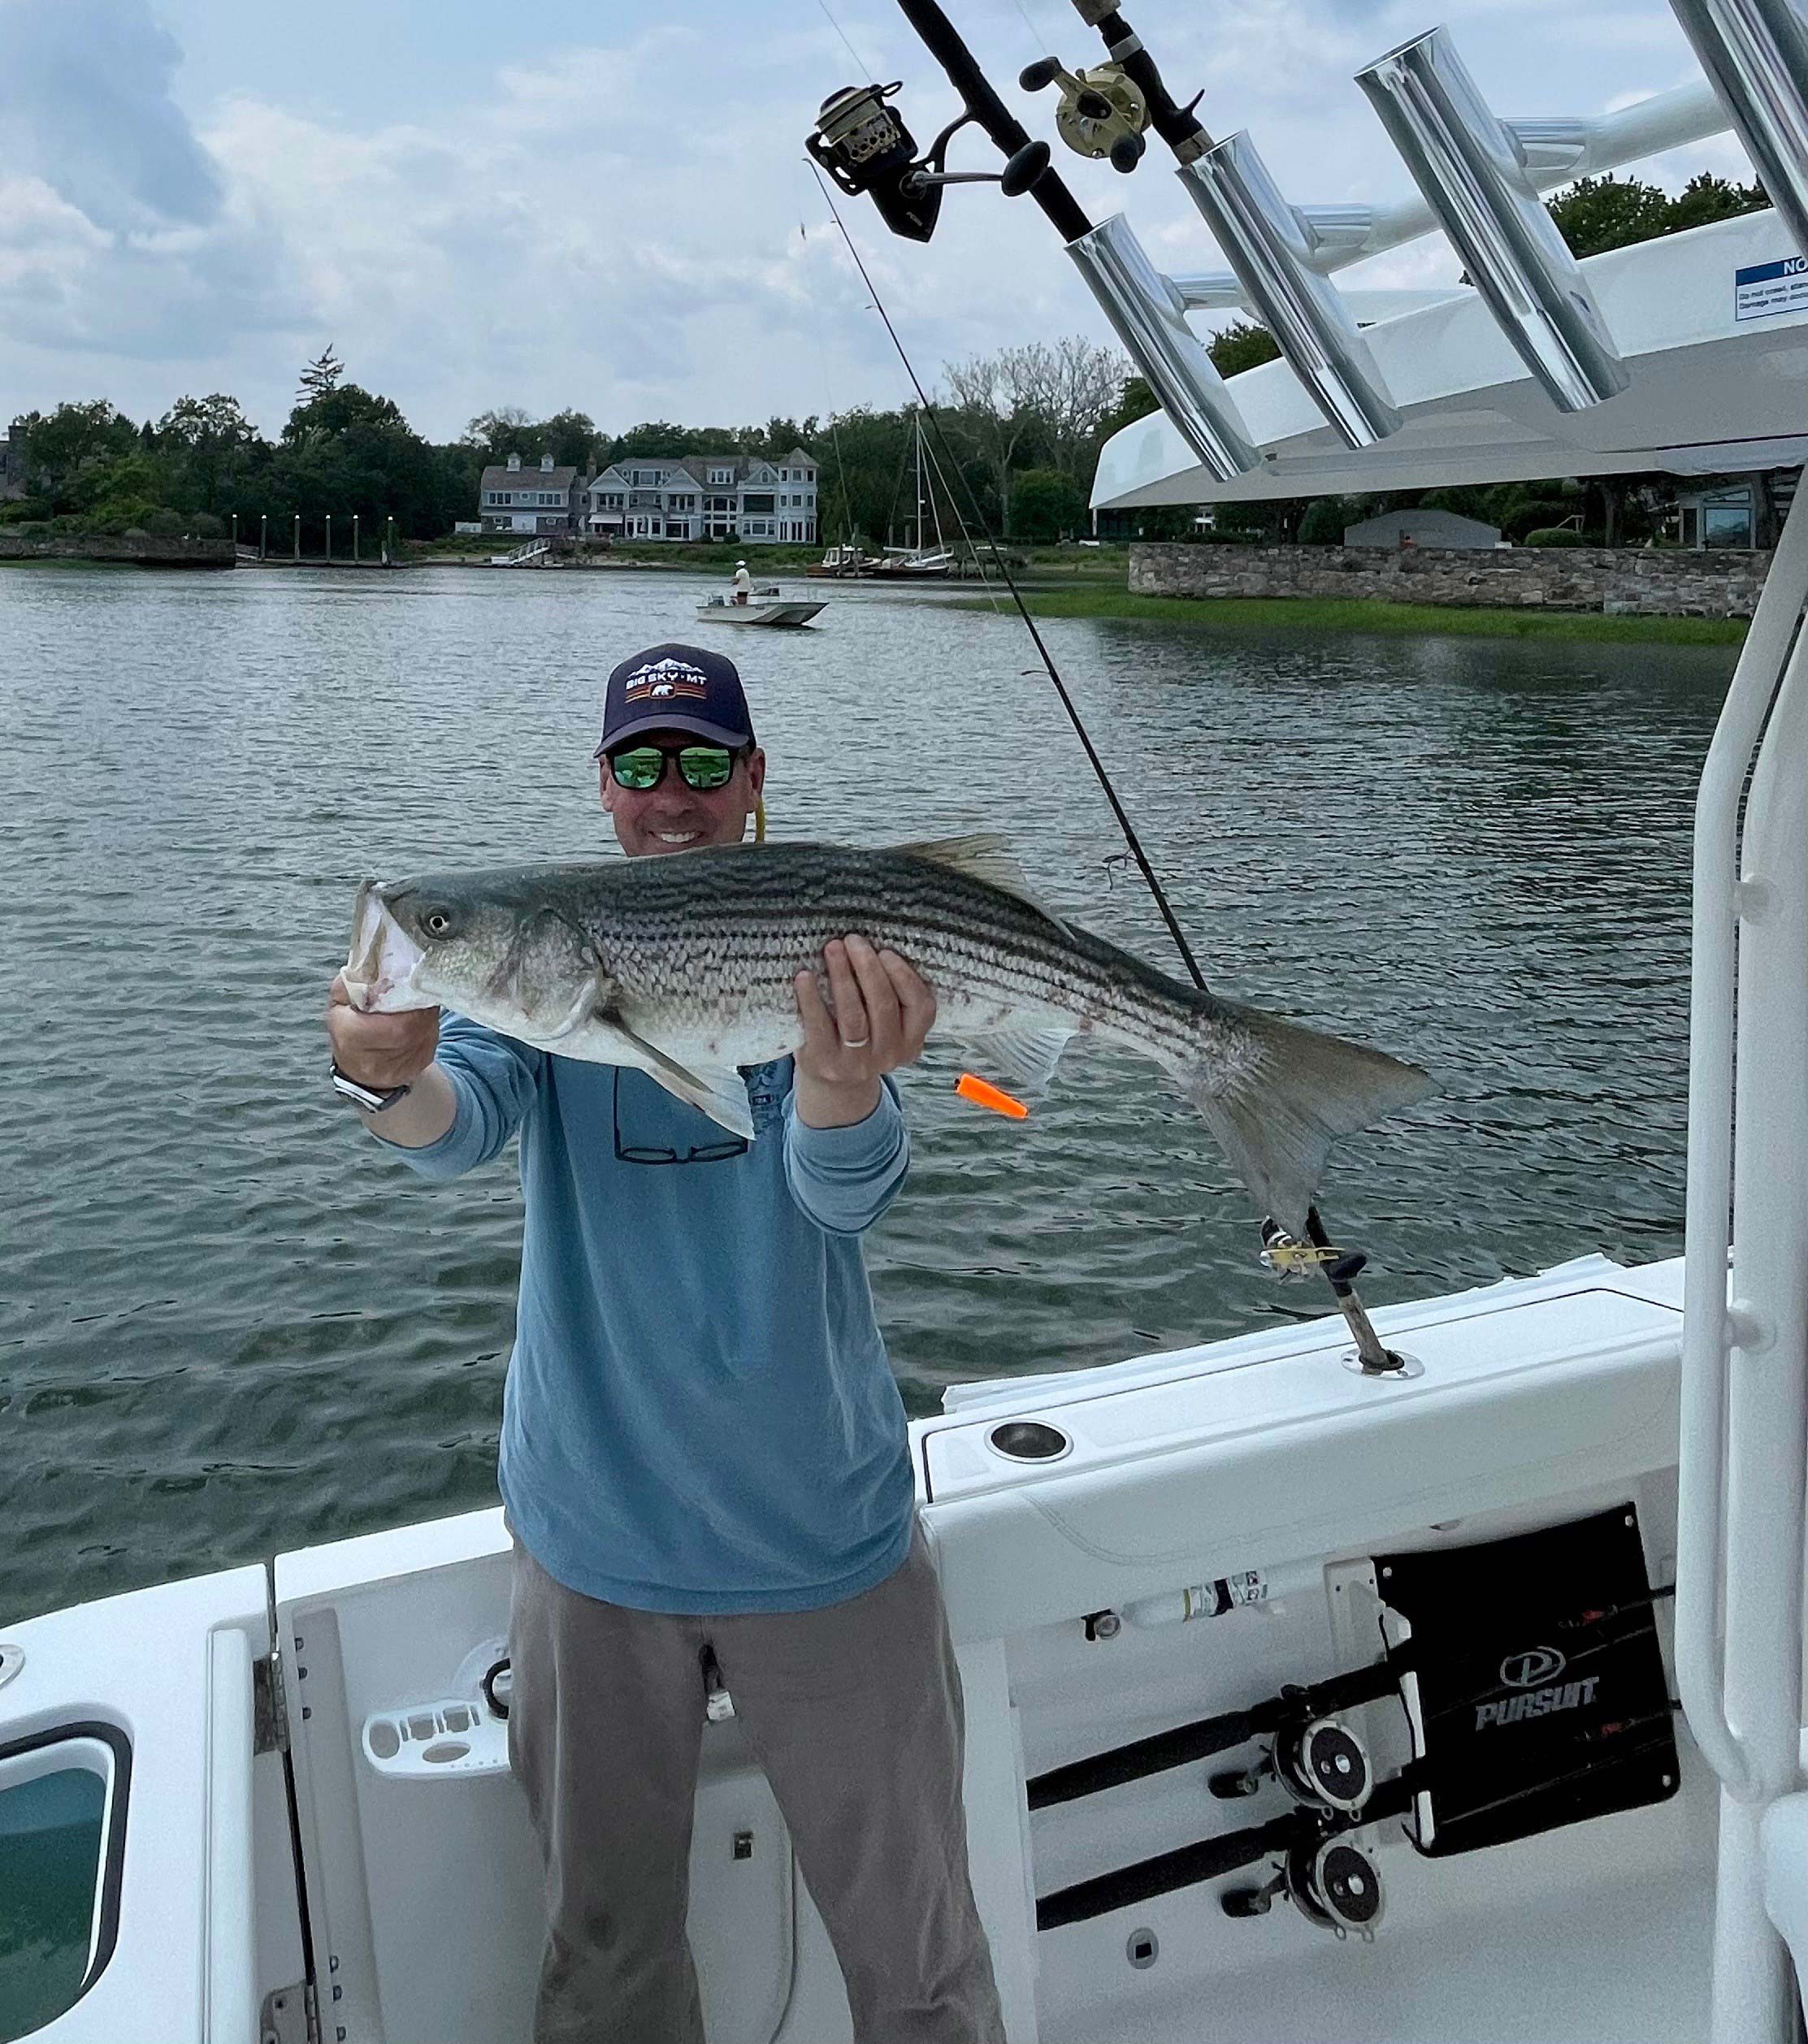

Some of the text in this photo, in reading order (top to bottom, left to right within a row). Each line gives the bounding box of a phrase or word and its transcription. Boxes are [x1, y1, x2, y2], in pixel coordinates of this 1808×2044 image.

[626, 676, 646, 690] BIG
[648, 673, 678, 682] SKY
[1476, 1676, 1599, 1730] PURSUIT
